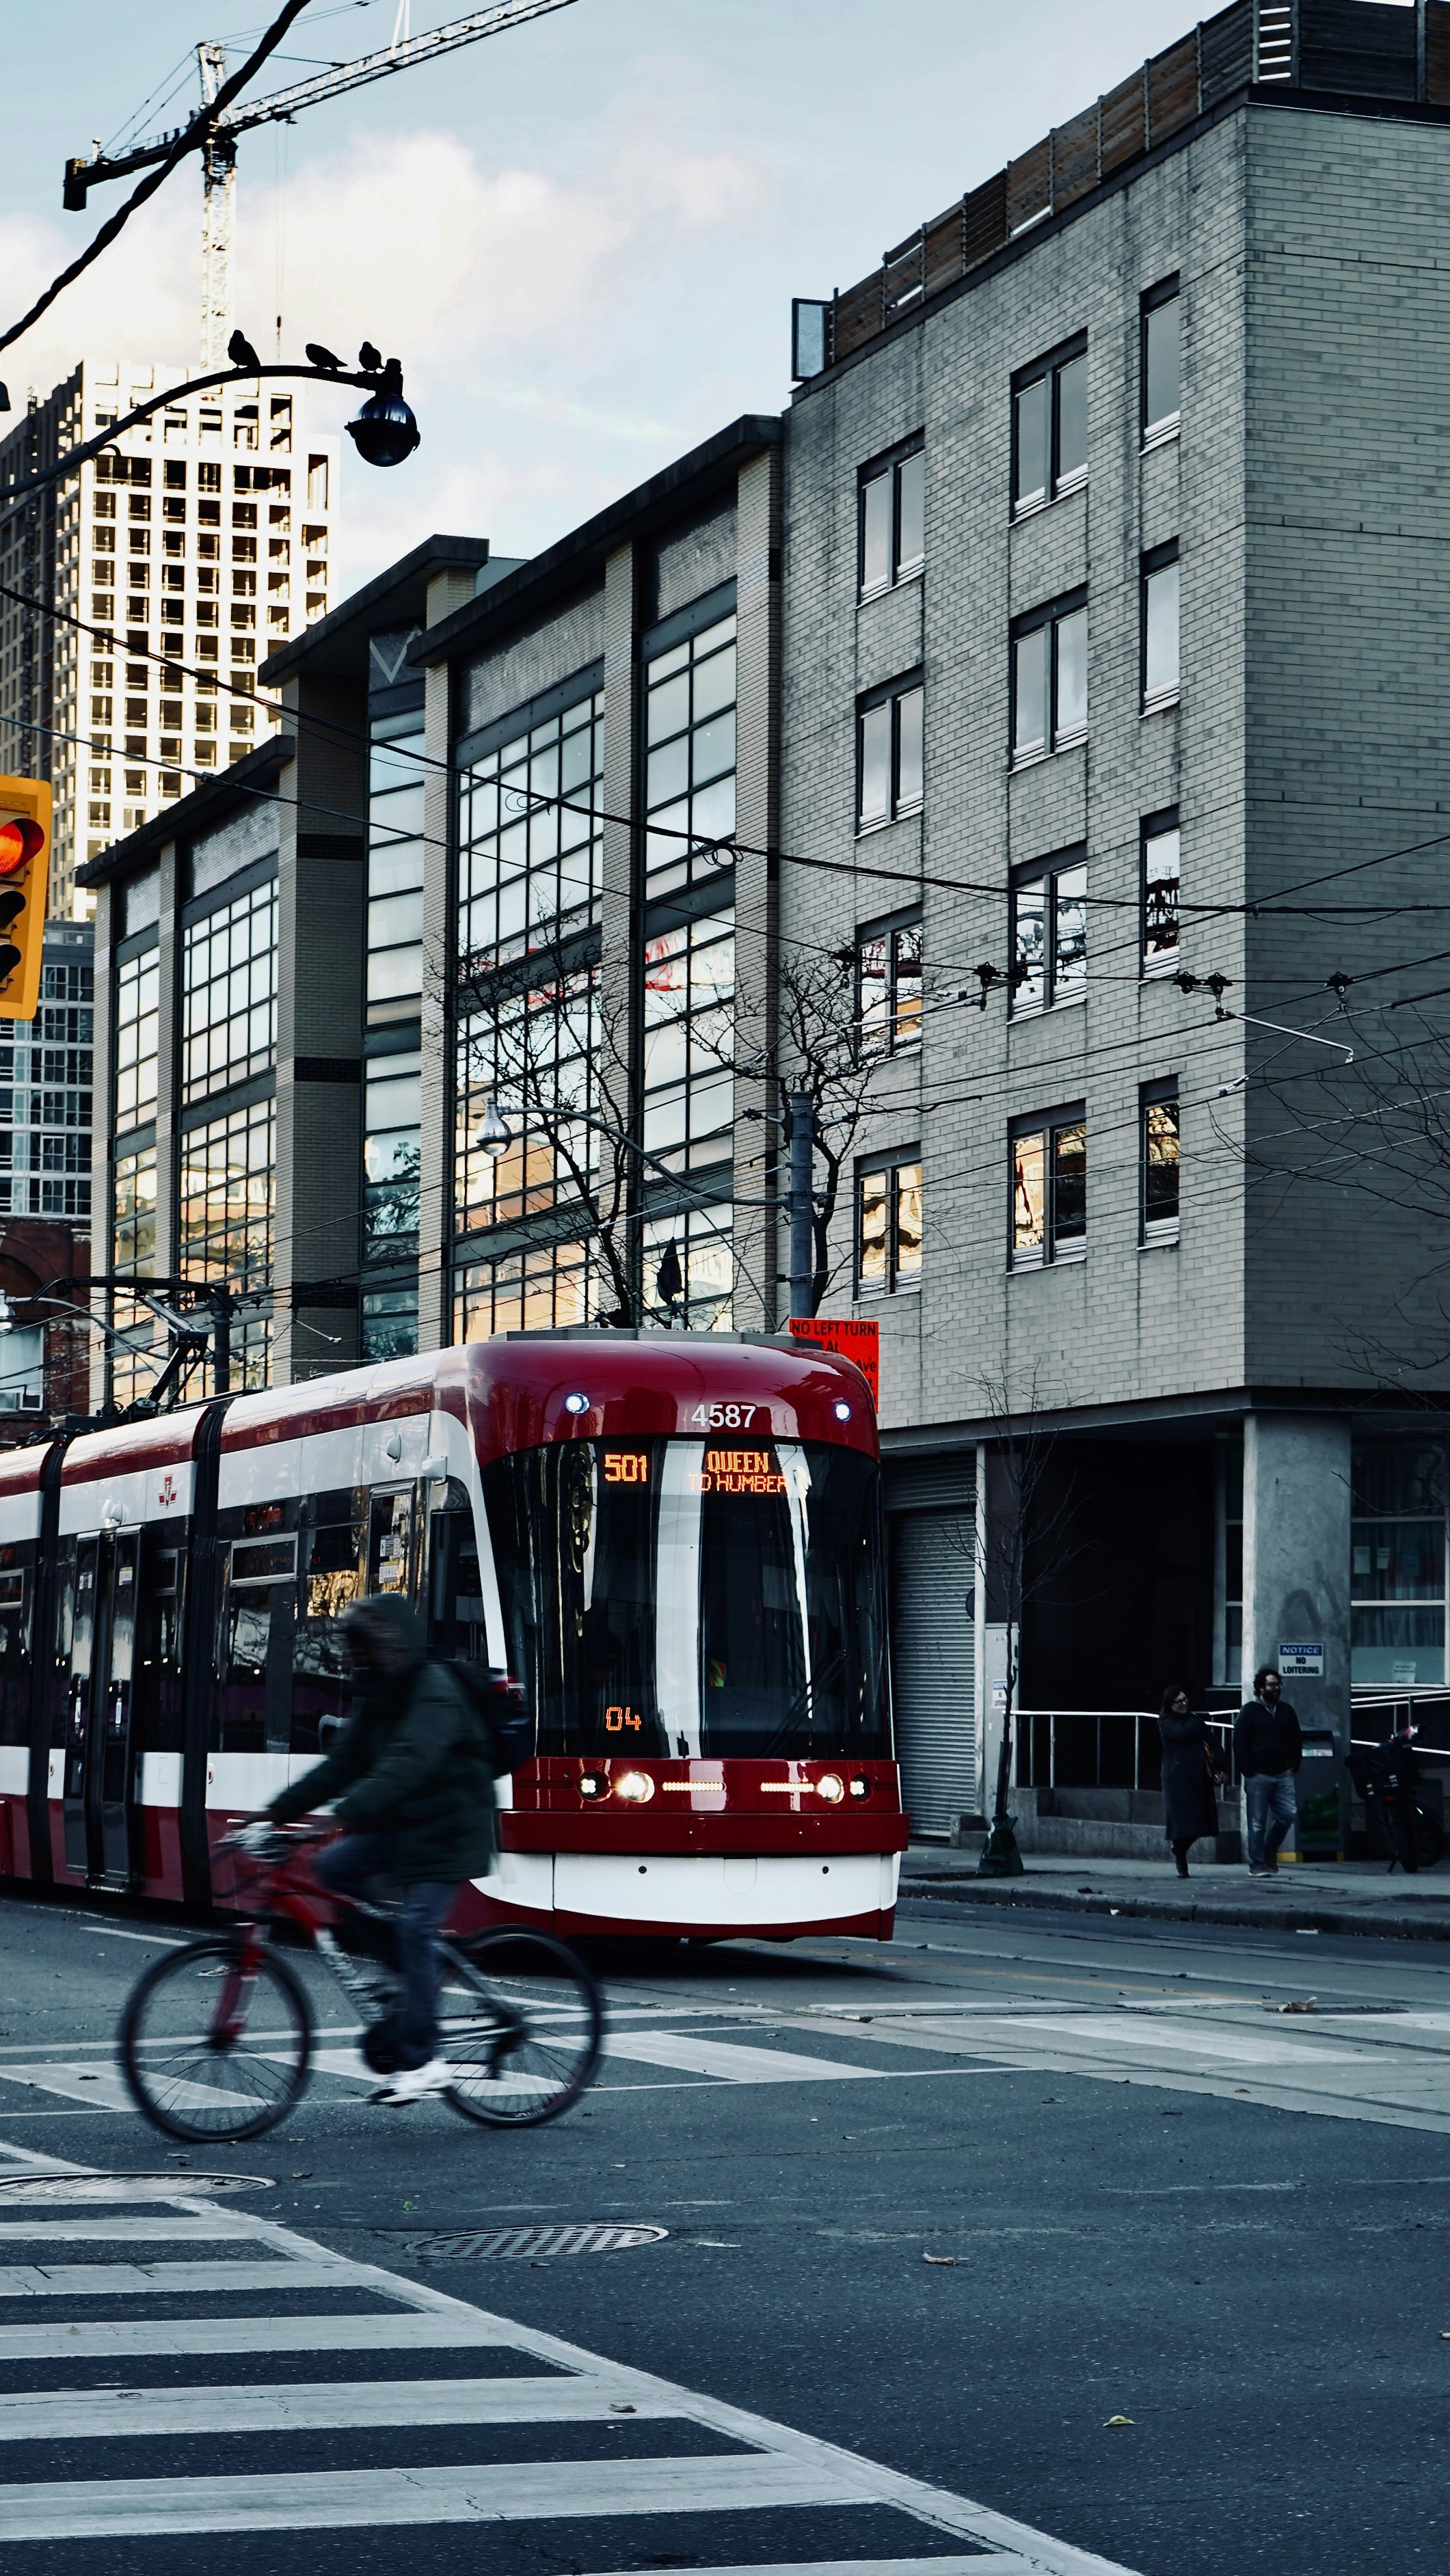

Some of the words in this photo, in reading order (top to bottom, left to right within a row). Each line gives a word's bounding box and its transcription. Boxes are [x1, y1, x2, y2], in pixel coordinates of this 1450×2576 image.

[792, 1322, 810, 1335] NO
[814, 1323, 840, 1336] LEFT
[844, 1323, 875, 1336] TURN
[826, 1340, 839, 1353] At
[691, 1404, 756, 1428] 4587
[604, 1454, 647, 1482] 501
[707, 1451, 769, 1474] QUEEN
[688, 1474, 712, 1491] TO
[716, 1475, 789, 1493] HUMBER
[1295, 1657, 1306, 1665] NO
[606, 1707, 641, 1731] 04
